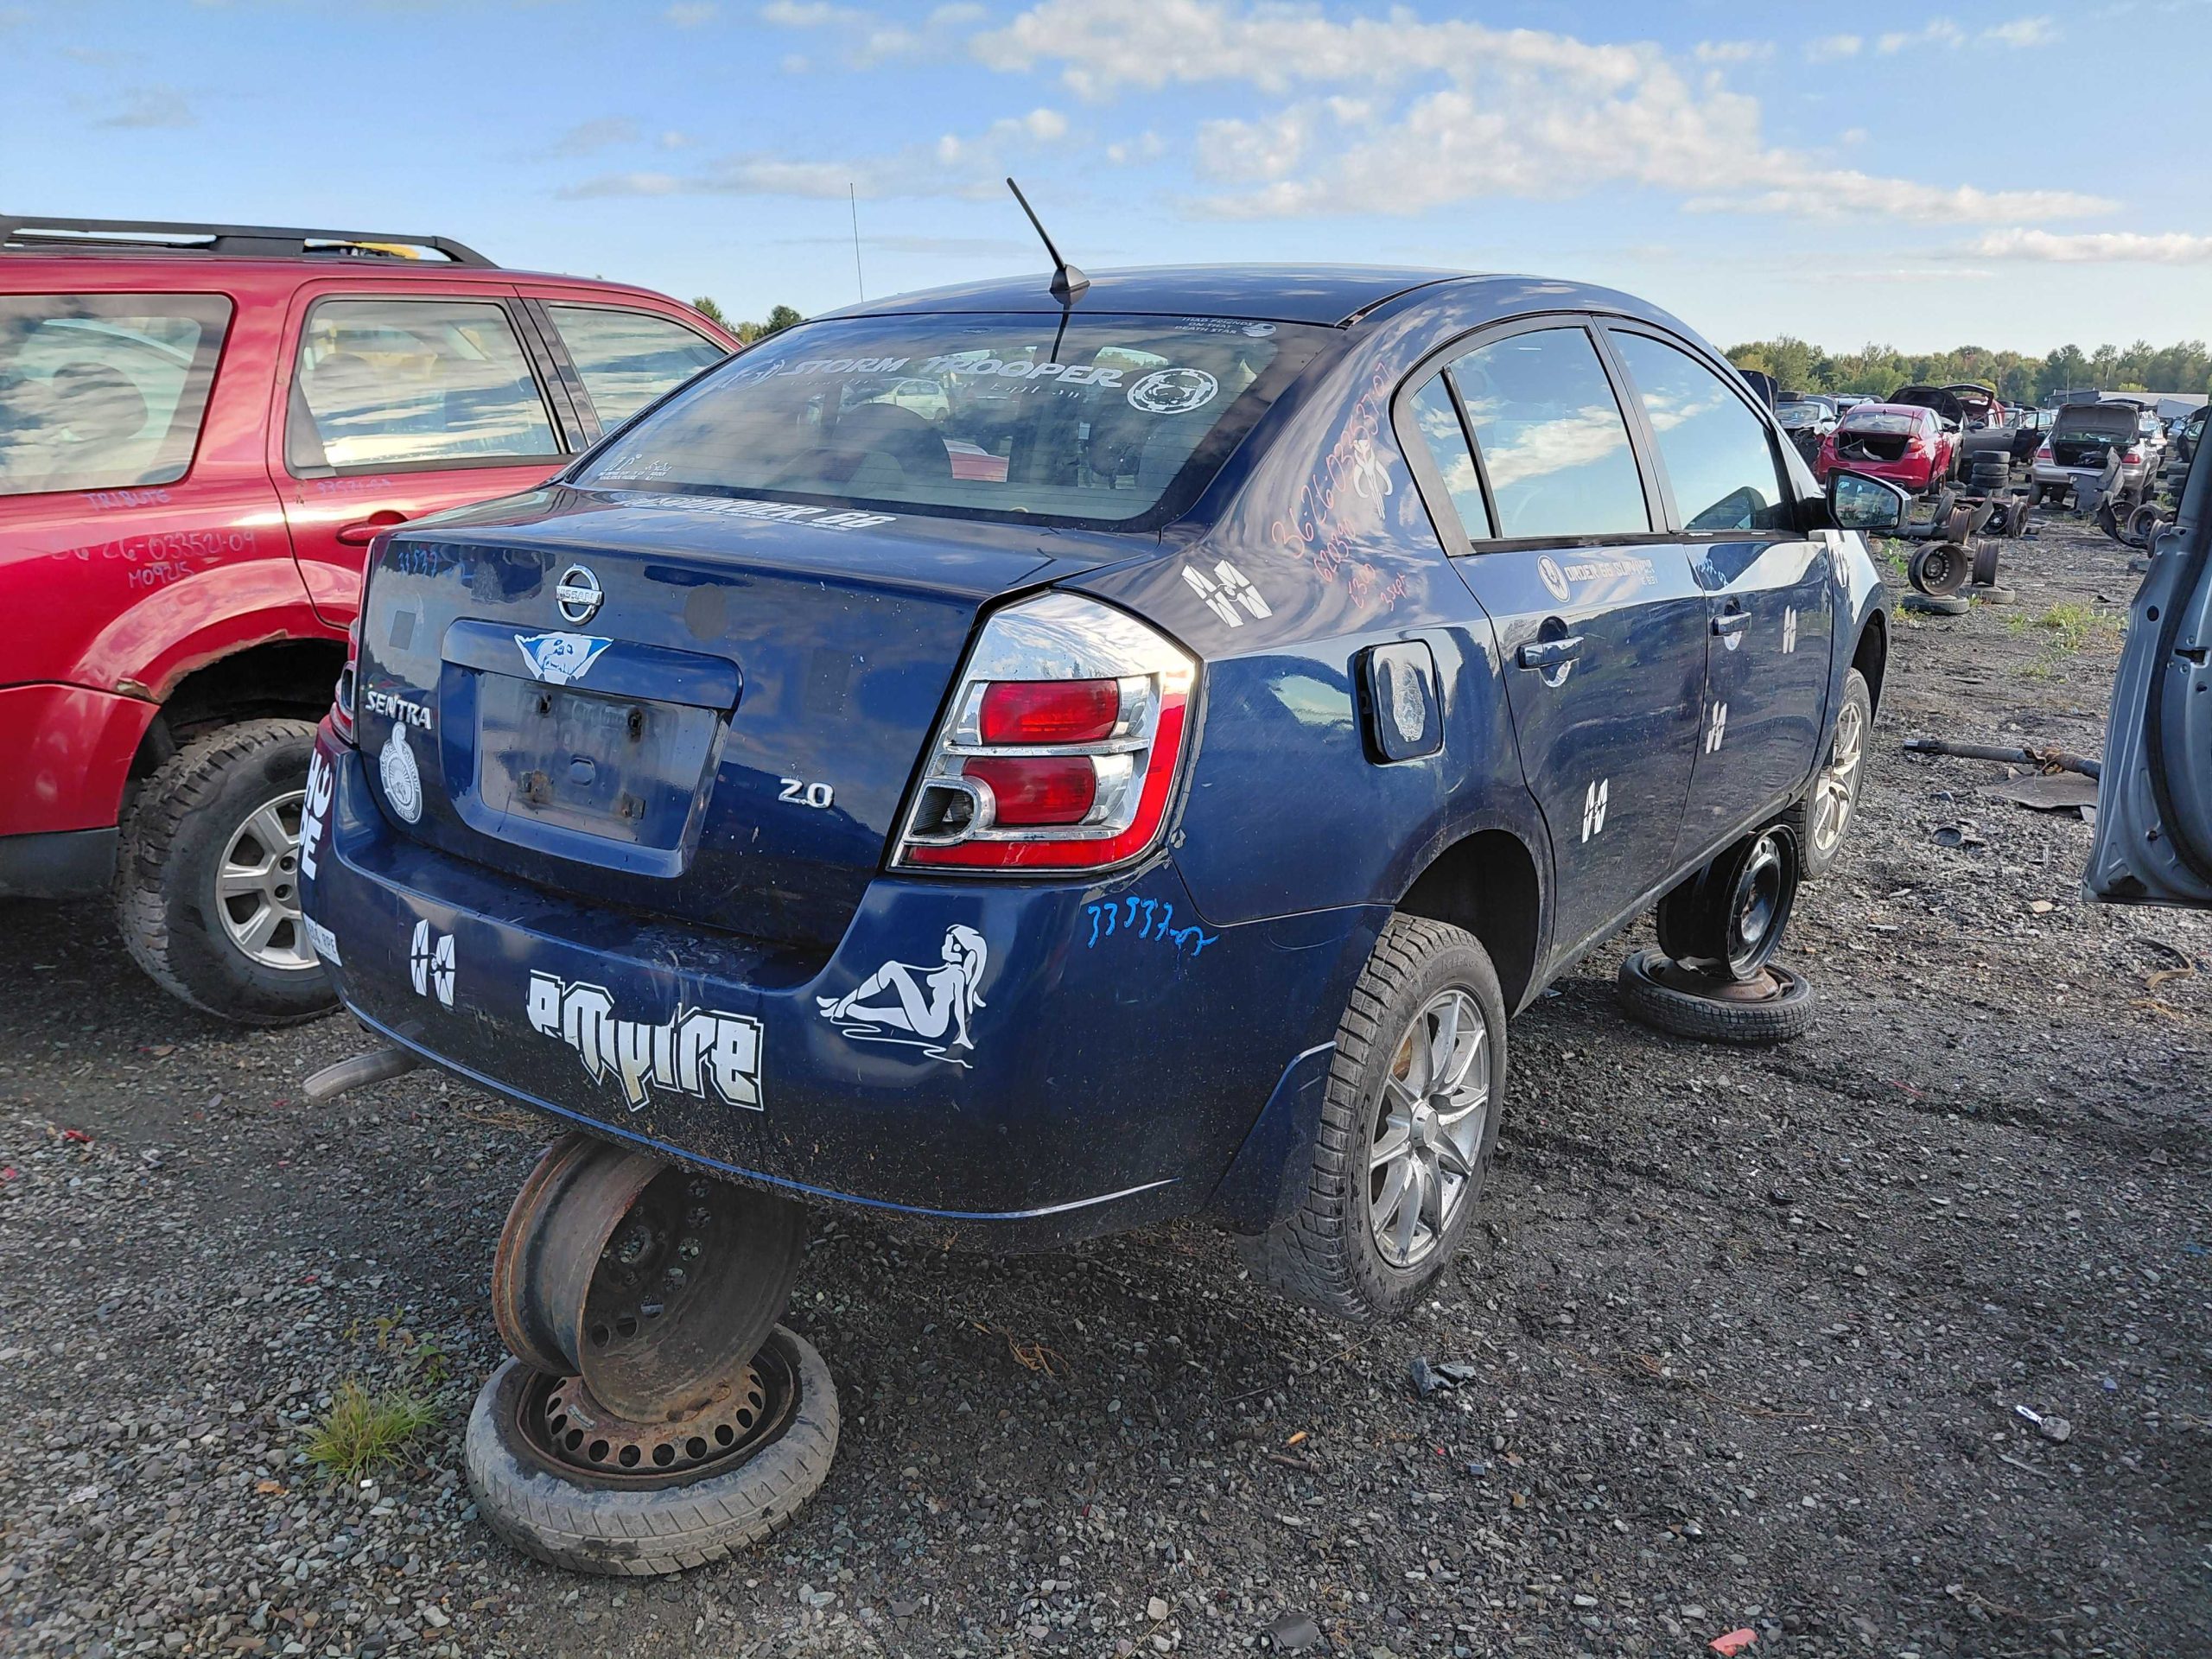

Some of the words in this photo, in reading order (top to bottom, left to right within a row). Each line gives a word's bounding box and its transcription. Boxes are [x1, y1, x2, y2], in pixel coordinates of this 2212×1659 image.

[1210, 318, 1254, 327] FRIENDS
[778, 357, 910, 376] STORM
[918, 357, 1122, 388] TROOPER
[80, 489, 171, 511] TRIBUTE
[812, 512, 897, 528] 66
[1564, 563, 1599, 582] ORDER
[1600, 563, 1615, 579] 66
[557, 587, 595, 601] NISSAN
[365, 691, 431, 729] SENTRA
[778, 778, 835, 809] 2.0
